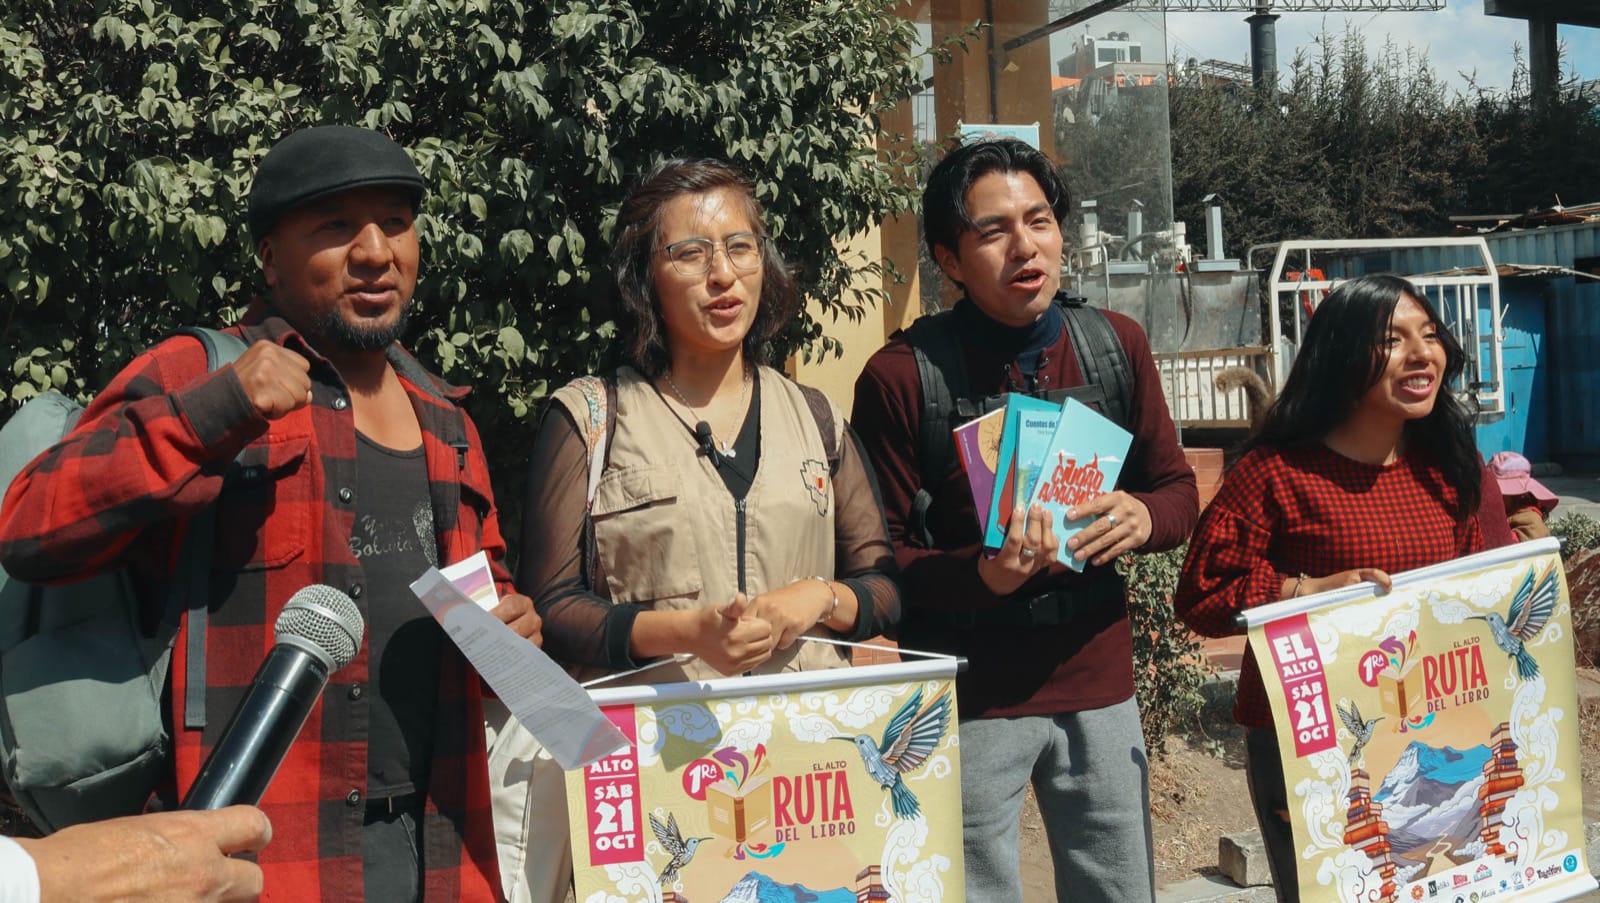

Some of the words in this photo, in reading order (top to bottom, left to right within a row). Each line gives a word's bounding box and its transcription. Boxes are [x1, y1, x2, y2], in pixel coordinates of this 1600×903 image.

[1026, 419, 1048, 428] Cuentos
[1048, 420, 1056, 429] de
[1272, 632, 1314, 664] EL
[1463, 636, 1480, 647] ALTO
[1282, 660, 1319, 677] ALTO
[1422, 645, 1488, 701] RUTA
[1291, 681, 1323, 700] SÁB
[1427, 698, 1447, 713] DEL
[1455, 687, 1490, 707] LIBRO
[1294, 694, 1328, 731] 21
[1299, 724, 1330, 744] OCT
[590, 759, 634, 774] ALTO
[813, 763, 824, 772] EL
[825, 760, 847, 770] ALTO
[594, 781, 634, 800] SÁB
[773, 770, 855, 828] RUTA
[593, 799, 635, 835] 21
[775, 827, 800, 843] DEL
[811, 820, 856, 839] LIBRO
[596, 834, 636, 851] OCT
